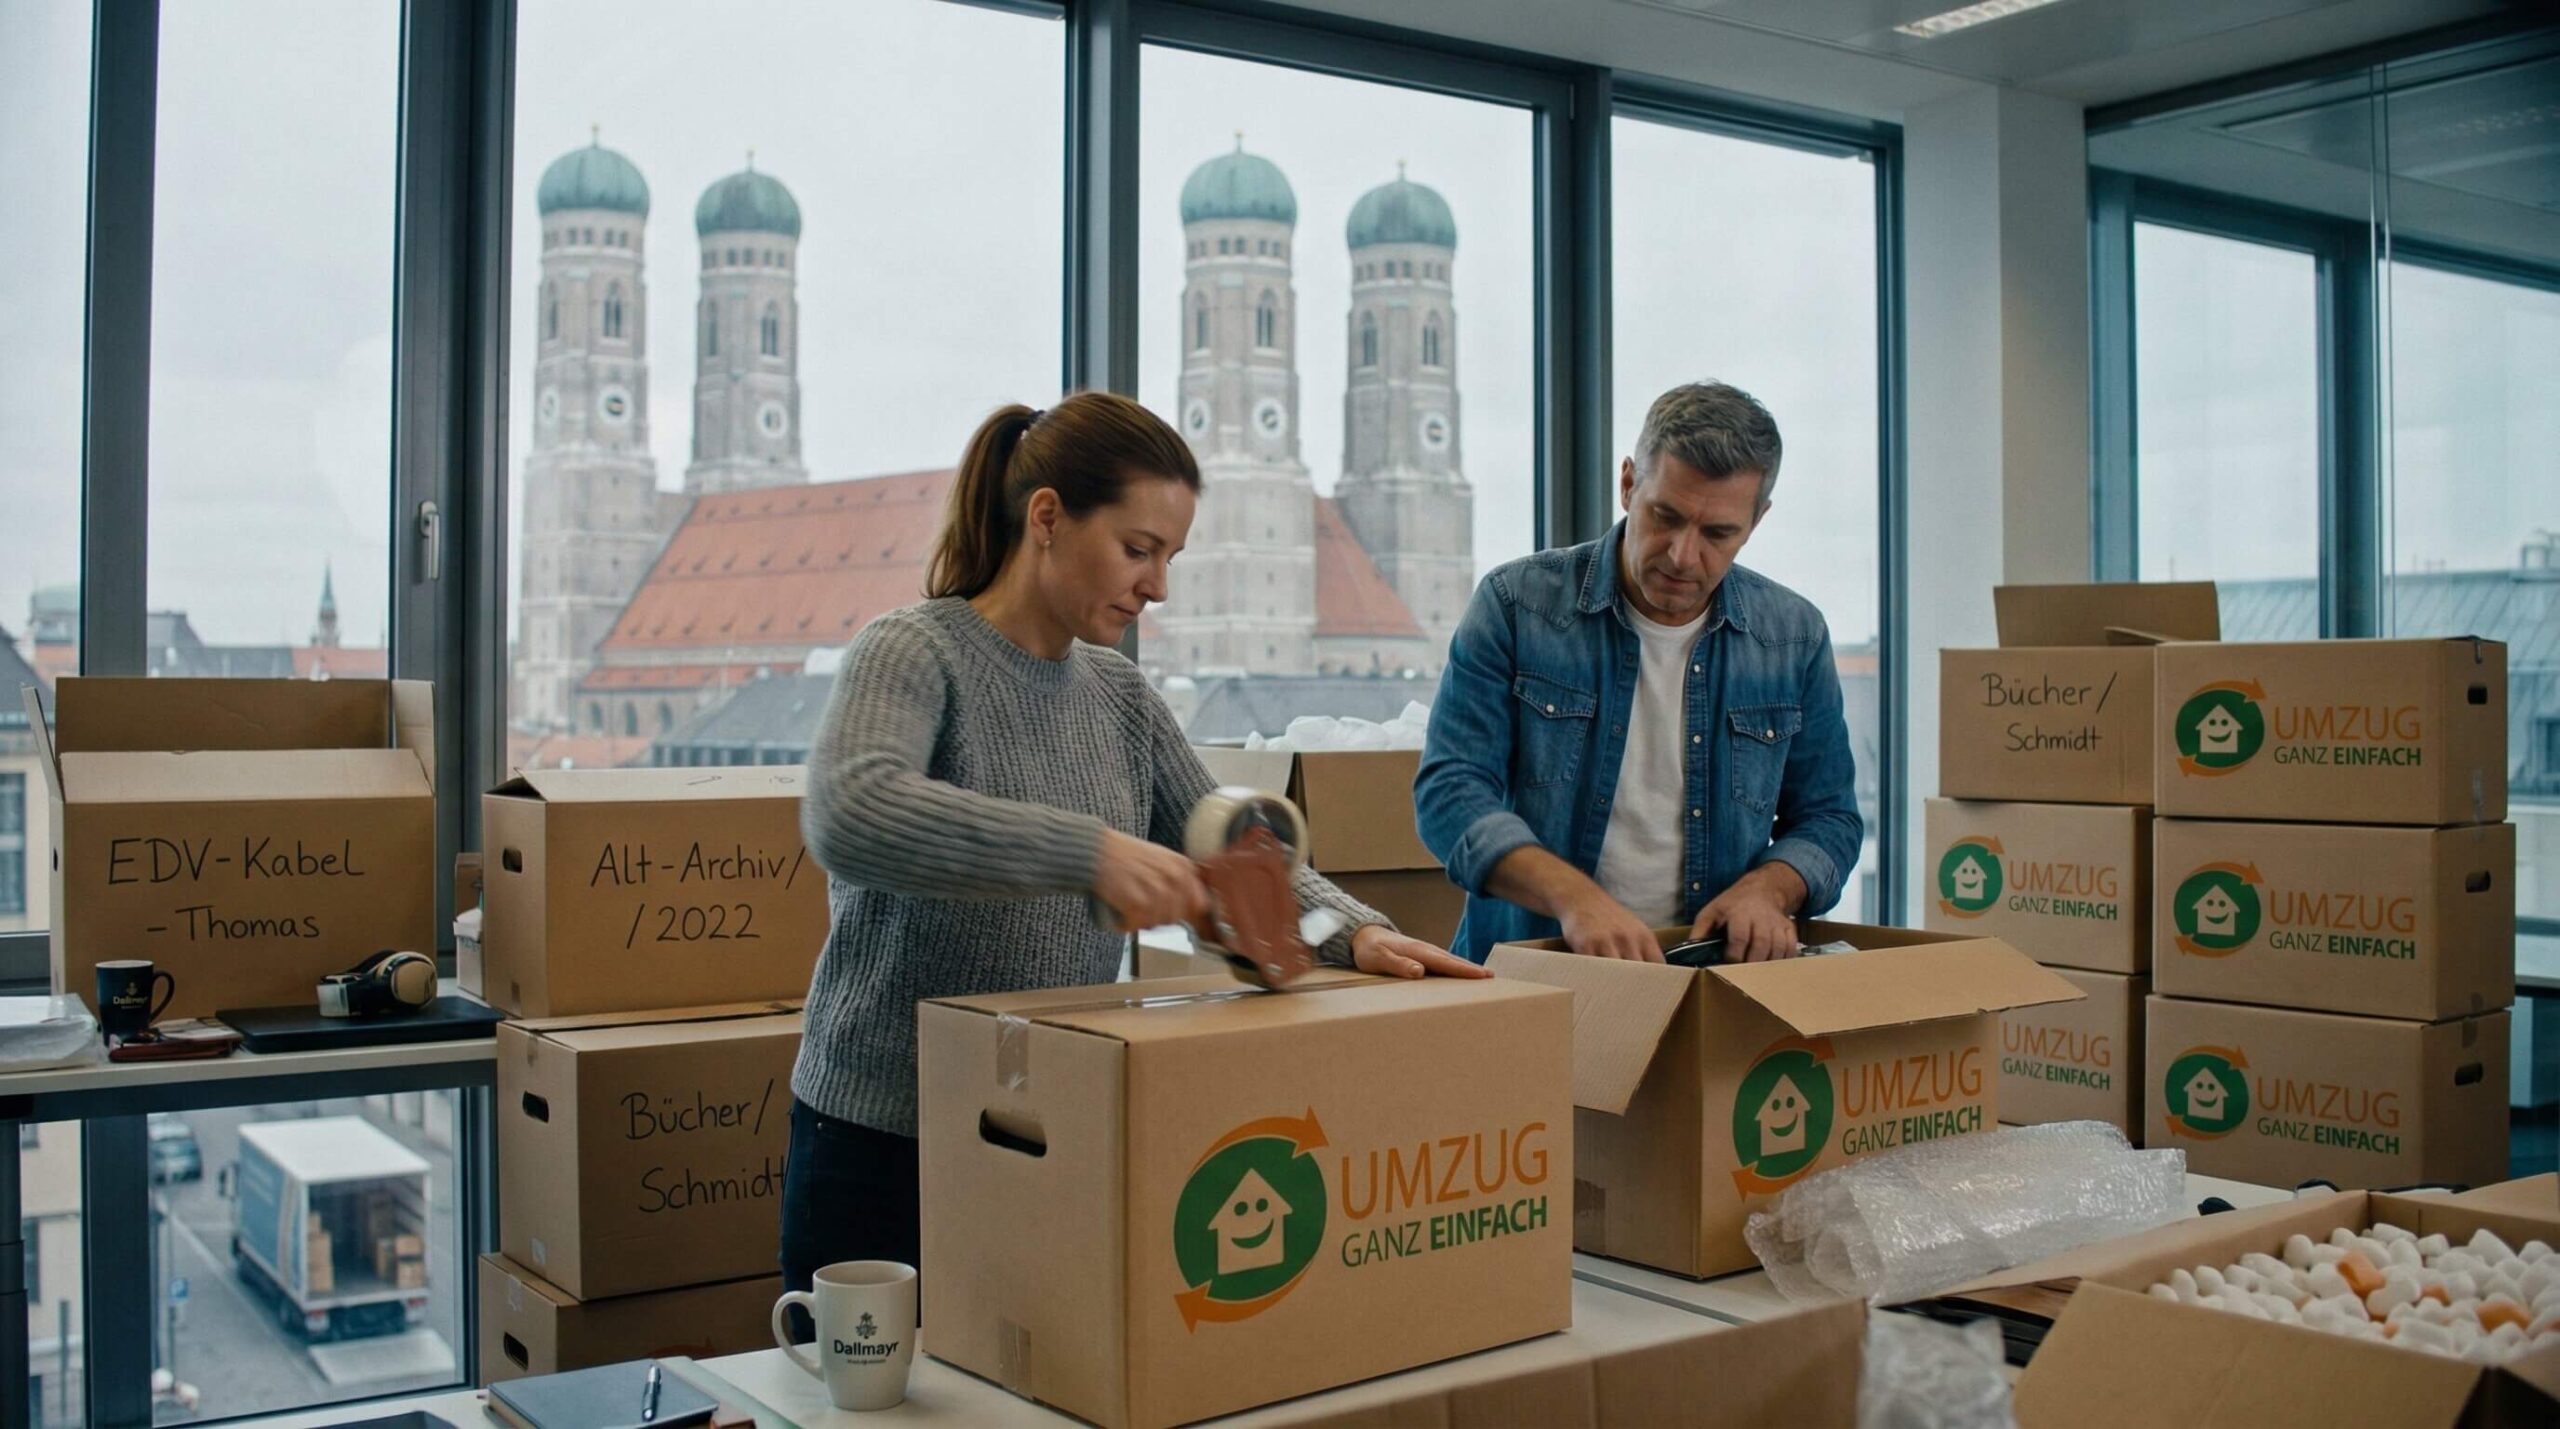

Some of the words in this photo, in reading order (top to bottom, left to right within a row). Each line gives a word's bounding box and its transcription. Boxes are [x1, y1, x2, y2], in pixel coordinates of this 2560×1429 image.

[1980, 671, 2118, 714] Bücher/
[2004, 722, 2104, 752] Schmidt
[2273, 704, 2422, 742] UMZUG
[2273, 745, 2329, 765] GANZ
[2333, 746, 2422, 767] EINFACH
[108, 836, 365, 885] EDV-Kabel
[2009, 860, 2118, 899] UMZUG
[2008, 895, 2049, 915] GANZ
[2052, 898, 2118, 921] EINFACH
[2269, 889, 2416, 934] UMZUG
[2269, 930, 2323, 953] GANZ
[2327, 934, 2416, 960] EINFACH
[2003, 1020, 2111, 1068] UMZUG
[1842, 1046, 1982, 1119] UMZUG
[2002, 1057, 2043, 1079] GANZ
[2045, 1063, 2111, 1092] EINFACH
[620, 1077, 775, 1141] Bücher/
[2256, 1076, 2401, 1129] UMZUG
[1841, 1120, 1898, 1156] GANZ
[1901, 1104, 1982, 1146] EINFACH
[2256, 1116, 2310, 1142] GANZ
[2313, 1124, 2401, 1156] EINFACH
[639, 1154, 786, 1214] Schmidt
[1341, 1121, 1549, 1221] UMZUG
[1341, 1221, 1423, 1268] GANZ
[1429, 1195, 1548, 1251] EINFACH
[834, 1338, 900, 1358] Dallmayr
